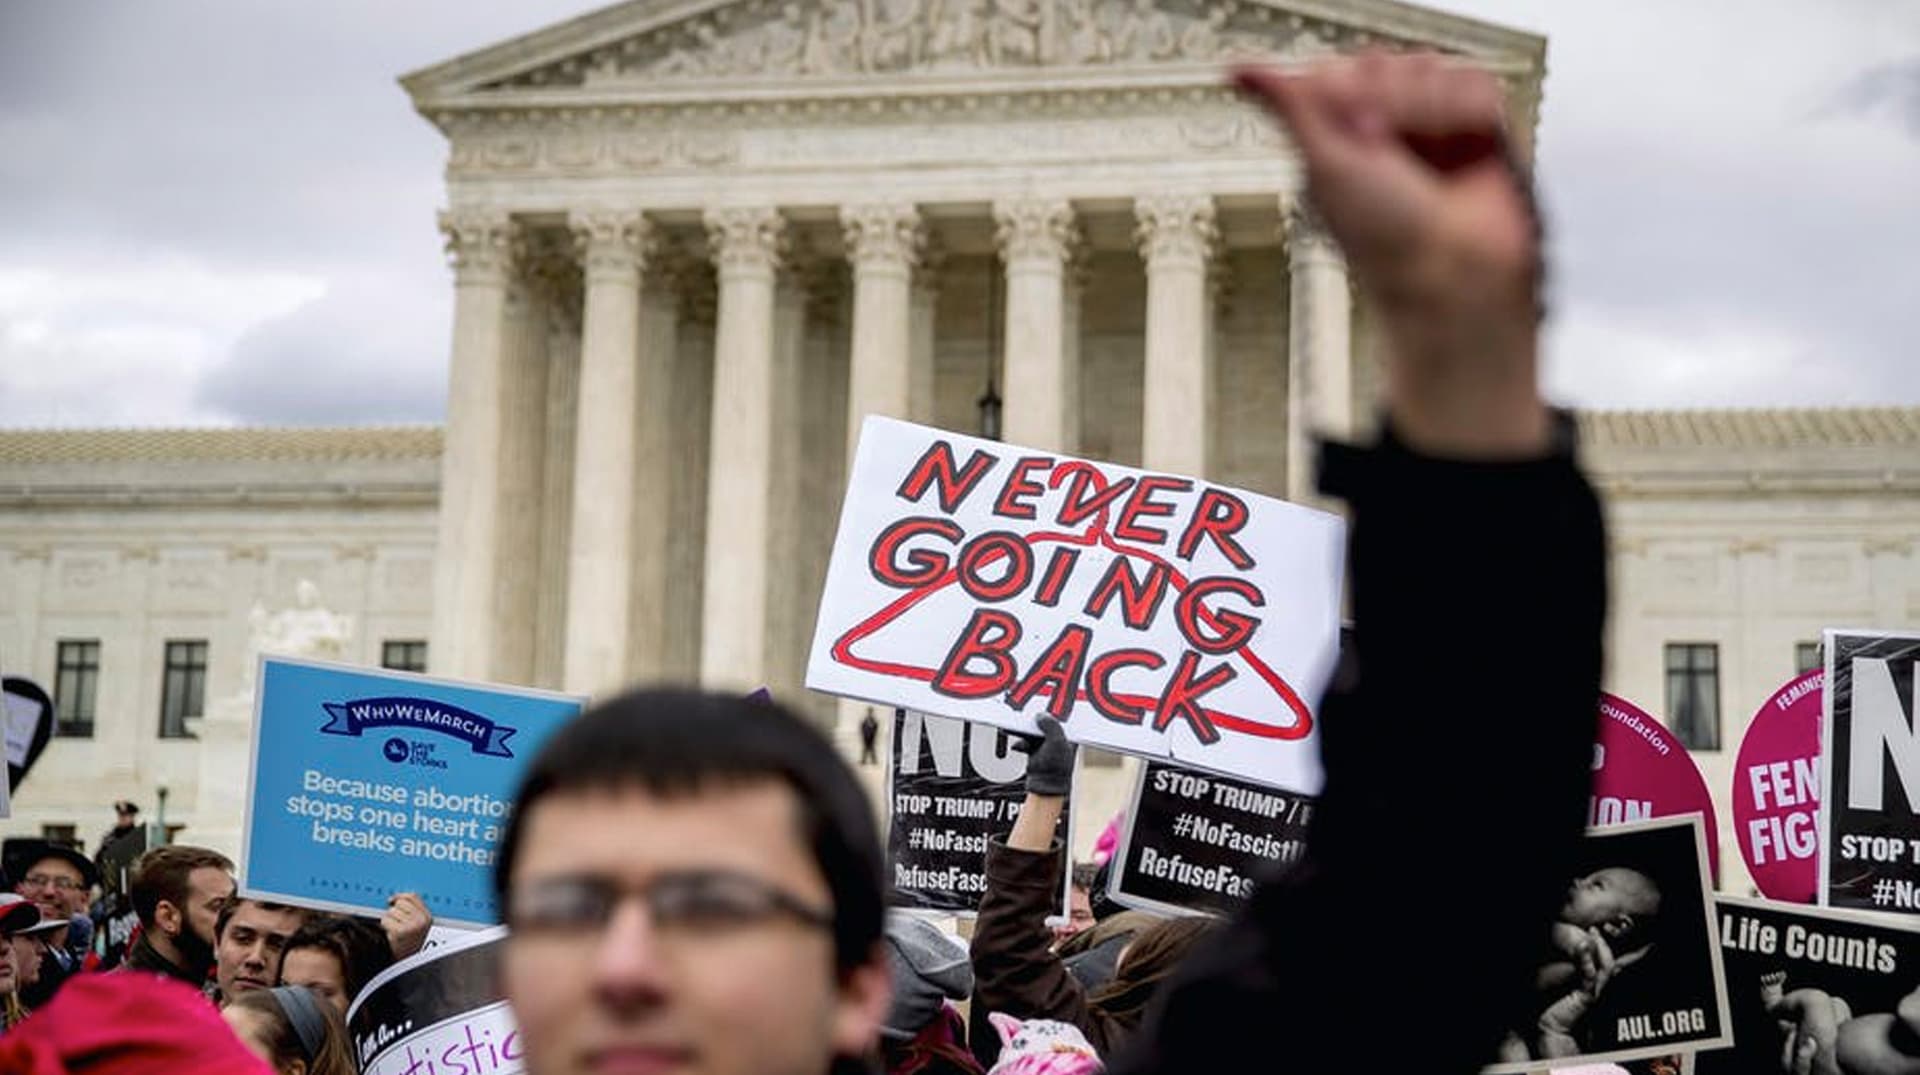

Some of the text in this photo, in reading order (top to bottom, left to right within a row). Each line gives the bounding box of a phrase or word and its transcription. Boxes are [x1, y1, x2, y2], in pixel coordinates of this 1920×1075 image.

[897, 440, 1256, 570] NEVER
[869, 516, 1266, 654] GOING
[932, 608, 1237, 745] BACK
[303, 770, 408, 804] Because
[896, 794, 931, 815] STOP
[934, 797, 994, 819] TRUMP
[1154, 770, 1209, 800] STOP
[1213, 782, 1286, 819] TRUMP
[287, 795, 353, 822] stops
[359, 806, 407, 829] one
[413, 810, 479, 839] heart
[313, 821, 395, 852] breaks
[1841, 834, 1905, 862] STOP
[1722, 914, 1897, 974] Life Counts
[1617, 1008, 1706, 1042] AUL.ORG
[398, 1025, 524, 1075] tistic
